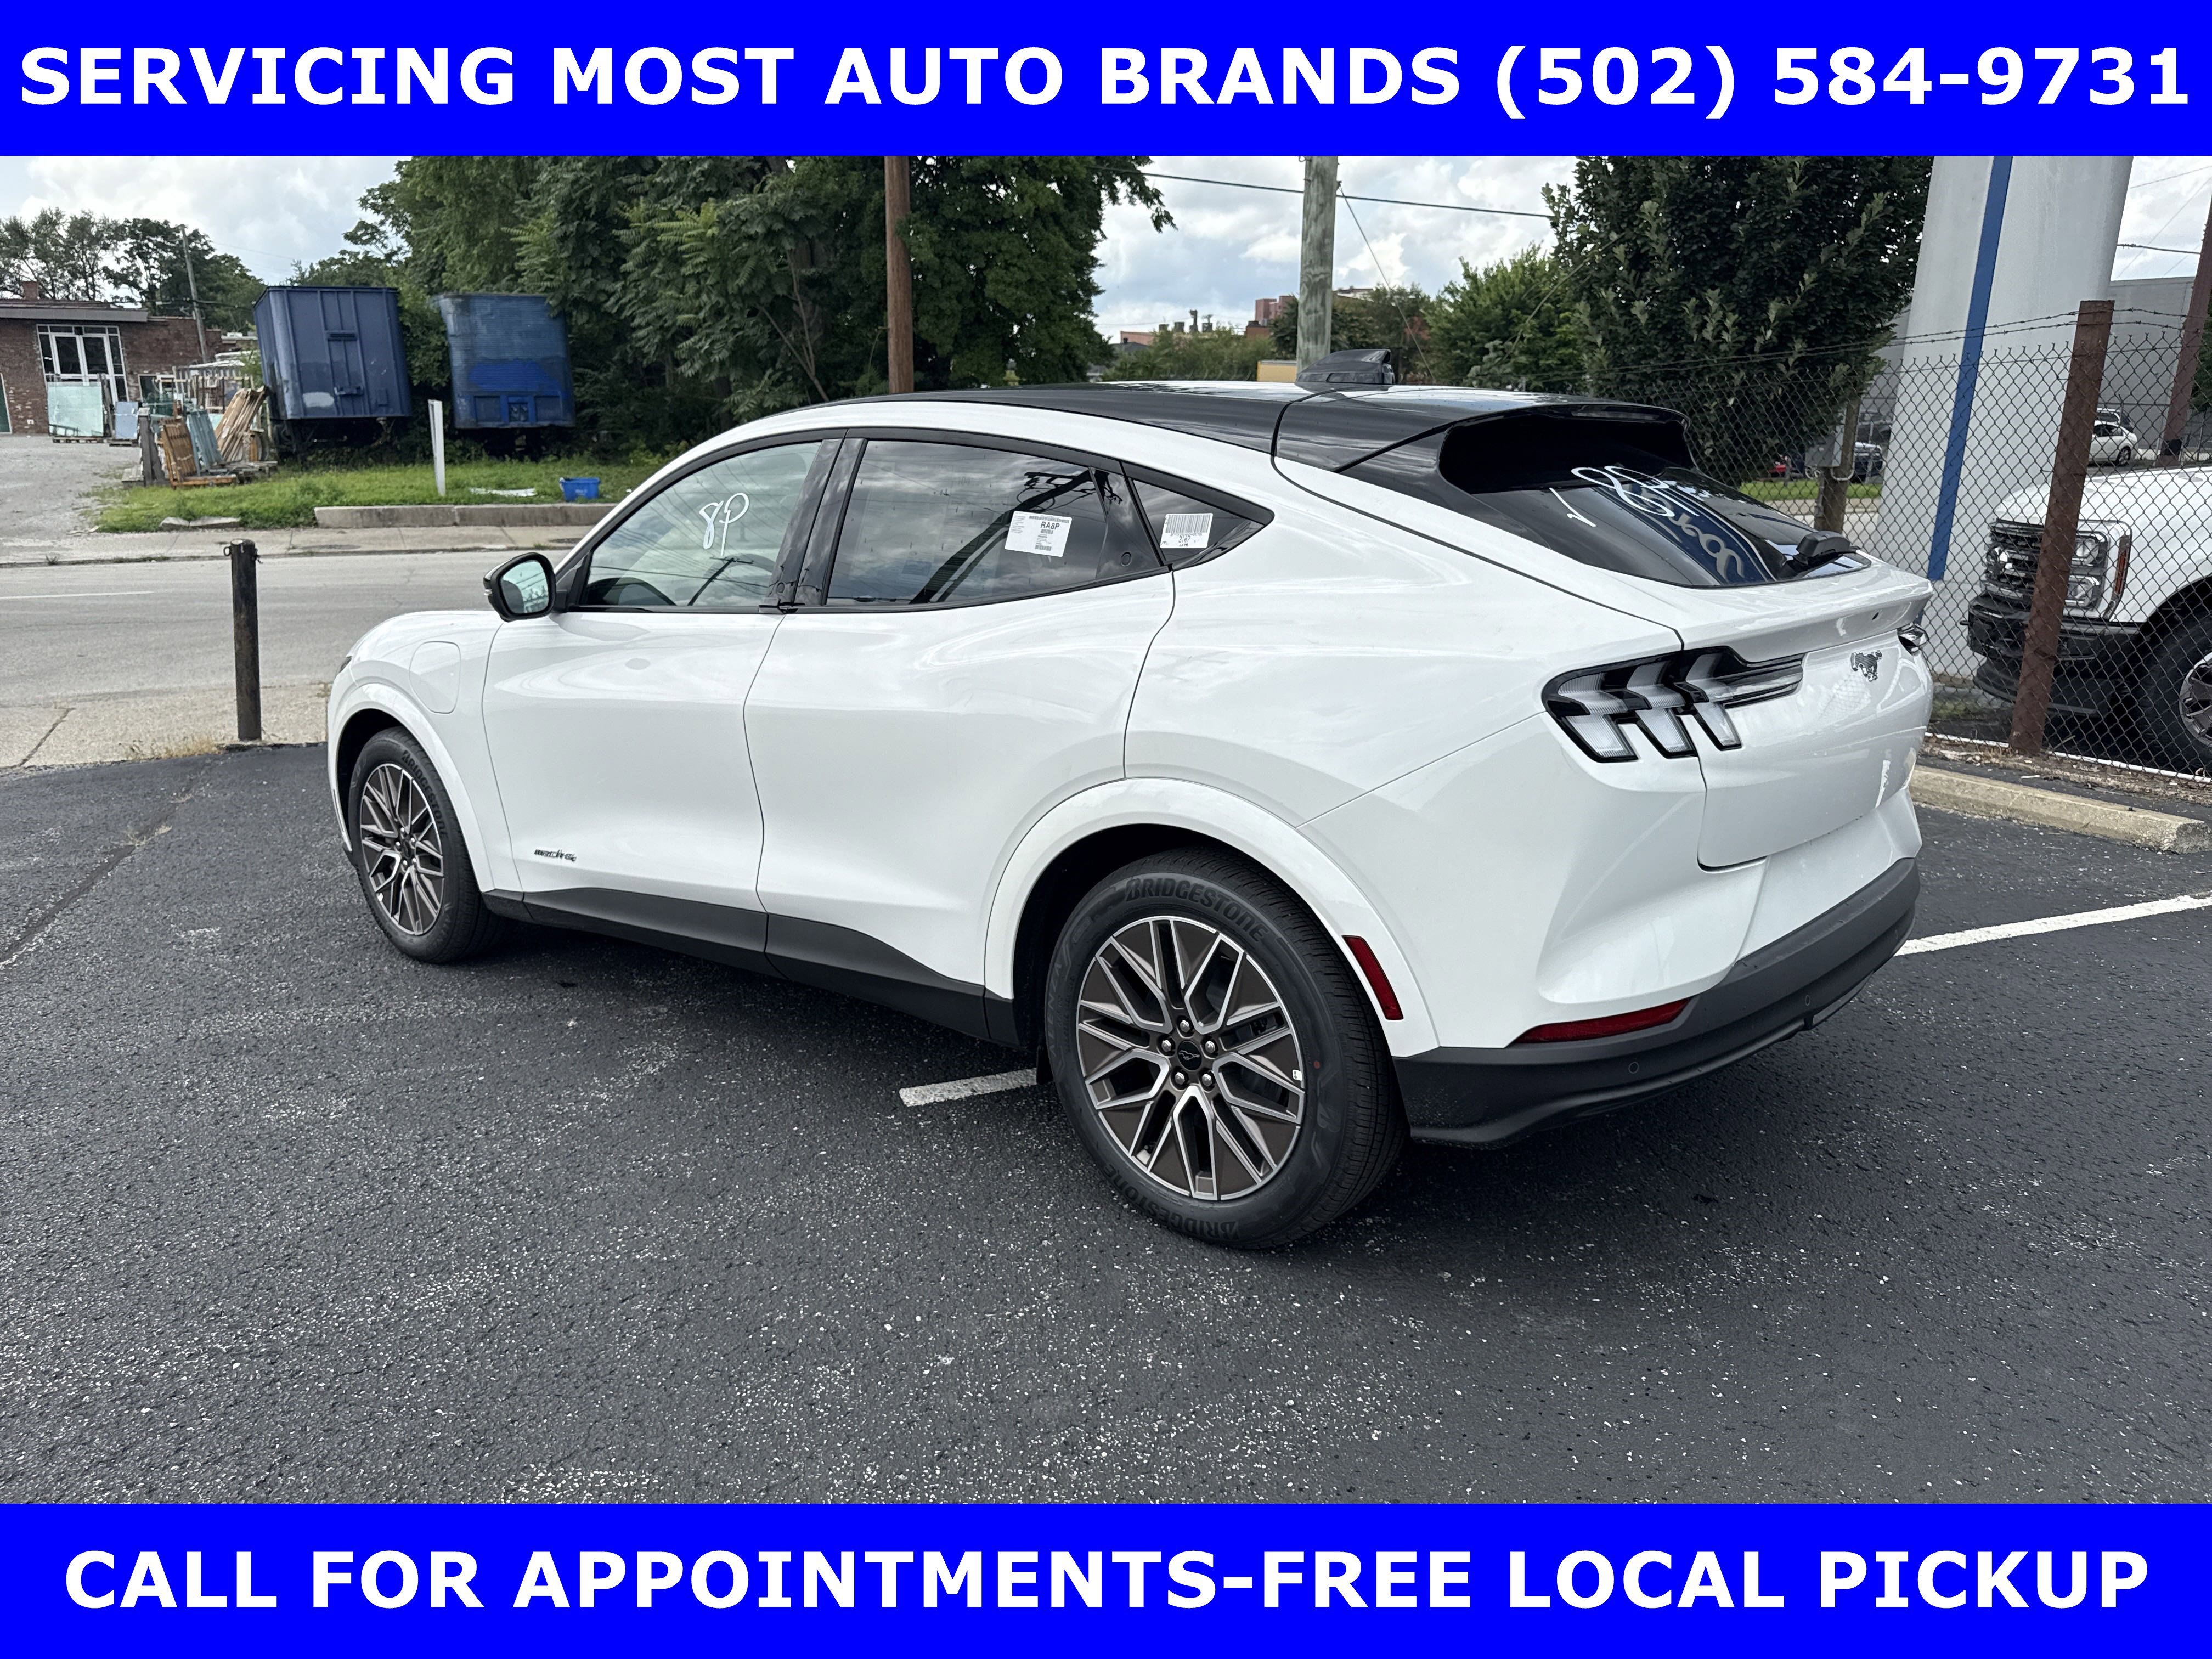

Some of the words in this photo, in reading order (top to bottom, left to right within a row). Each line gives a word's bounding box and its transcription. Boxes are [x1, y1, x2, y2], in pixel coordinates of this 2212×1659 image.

[699, 492, 749, 556] 8P
[1040, 521, 1060, 530] RA8P
[1126, 877, 1269, 943] BRIDGESTONE
[1047, 961, 1063, 1058] ALENZA
[1103, 1164, 1240, 1240] BRIDGESTONE
